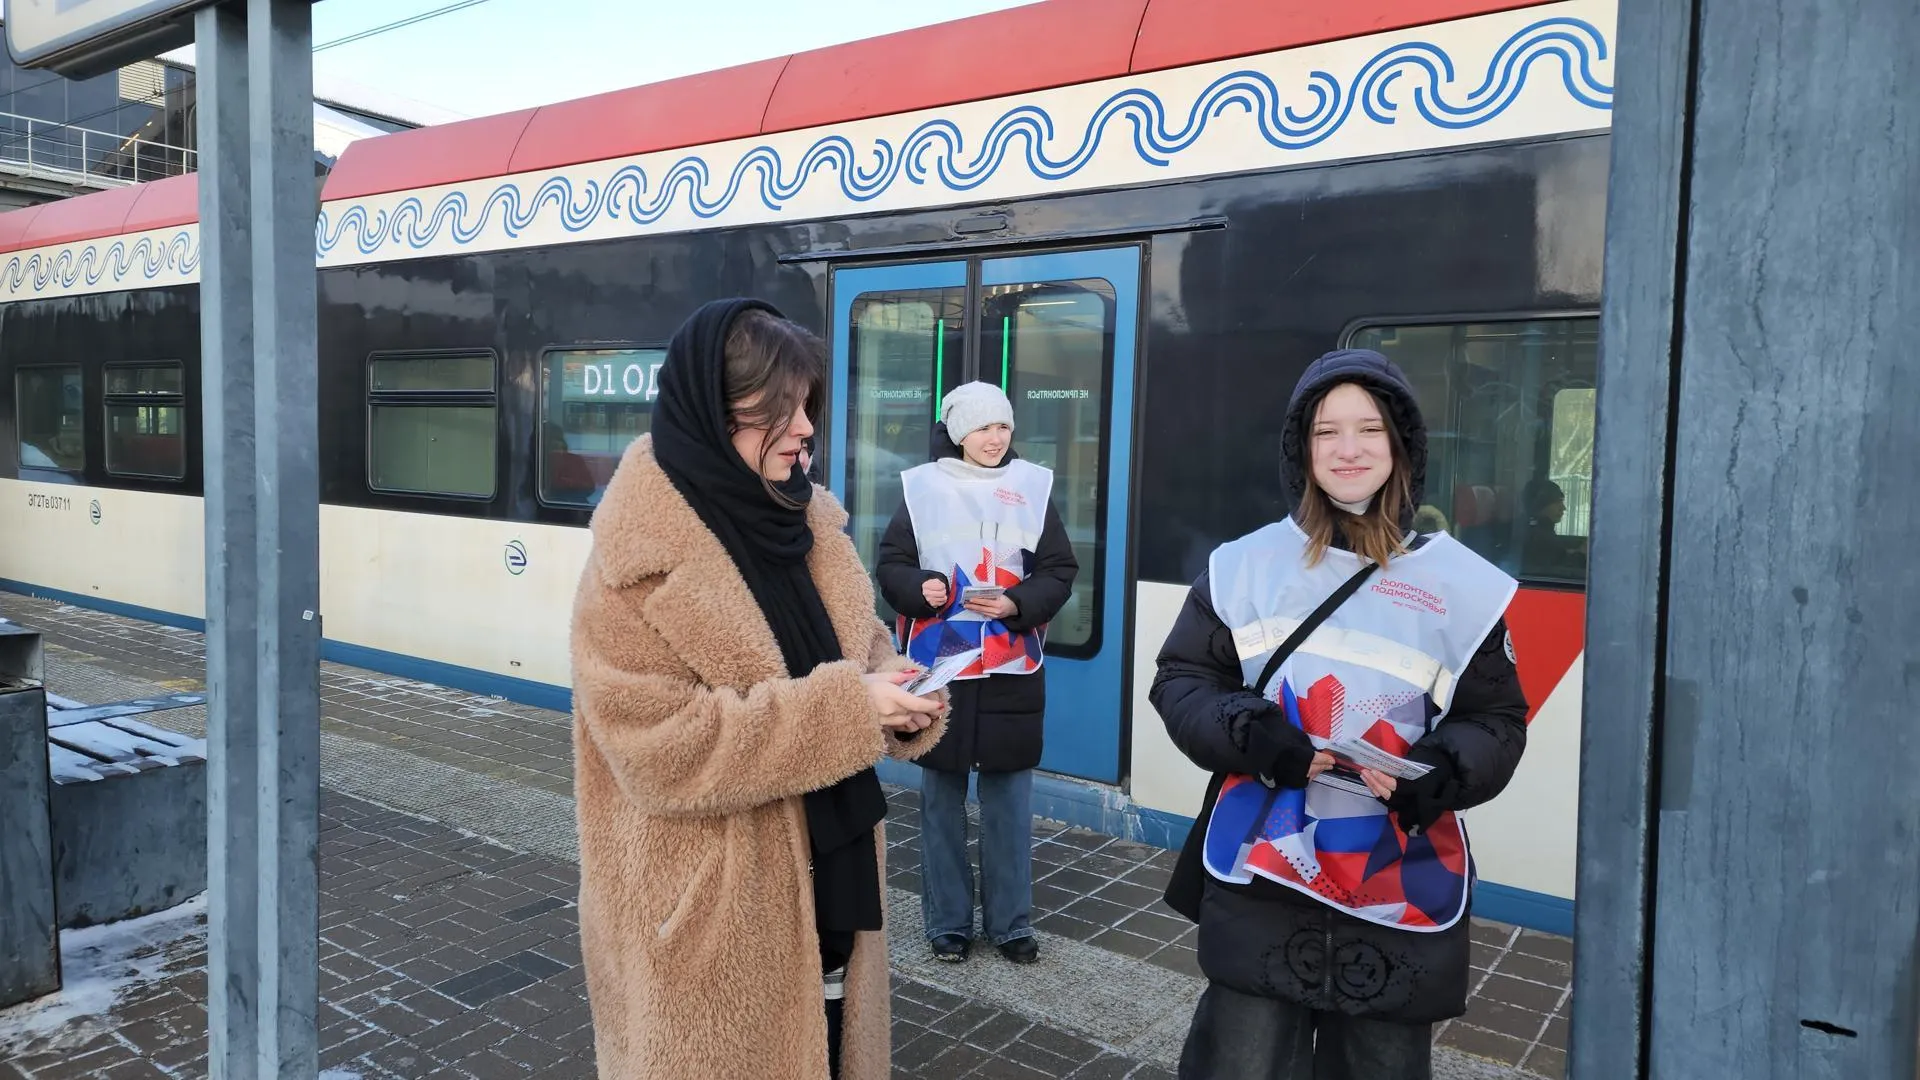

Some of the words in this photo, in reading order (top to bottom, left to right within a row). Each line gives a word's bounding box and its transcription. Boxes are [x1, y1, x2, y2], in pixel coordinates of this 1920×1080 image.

[584, 364, 616, 395] D1
[1370, 584, 1447, 616] ПОДМОСКОВЬЯ
[1380, 578, 1443, 605] ВОЛОНТЕРЫ
